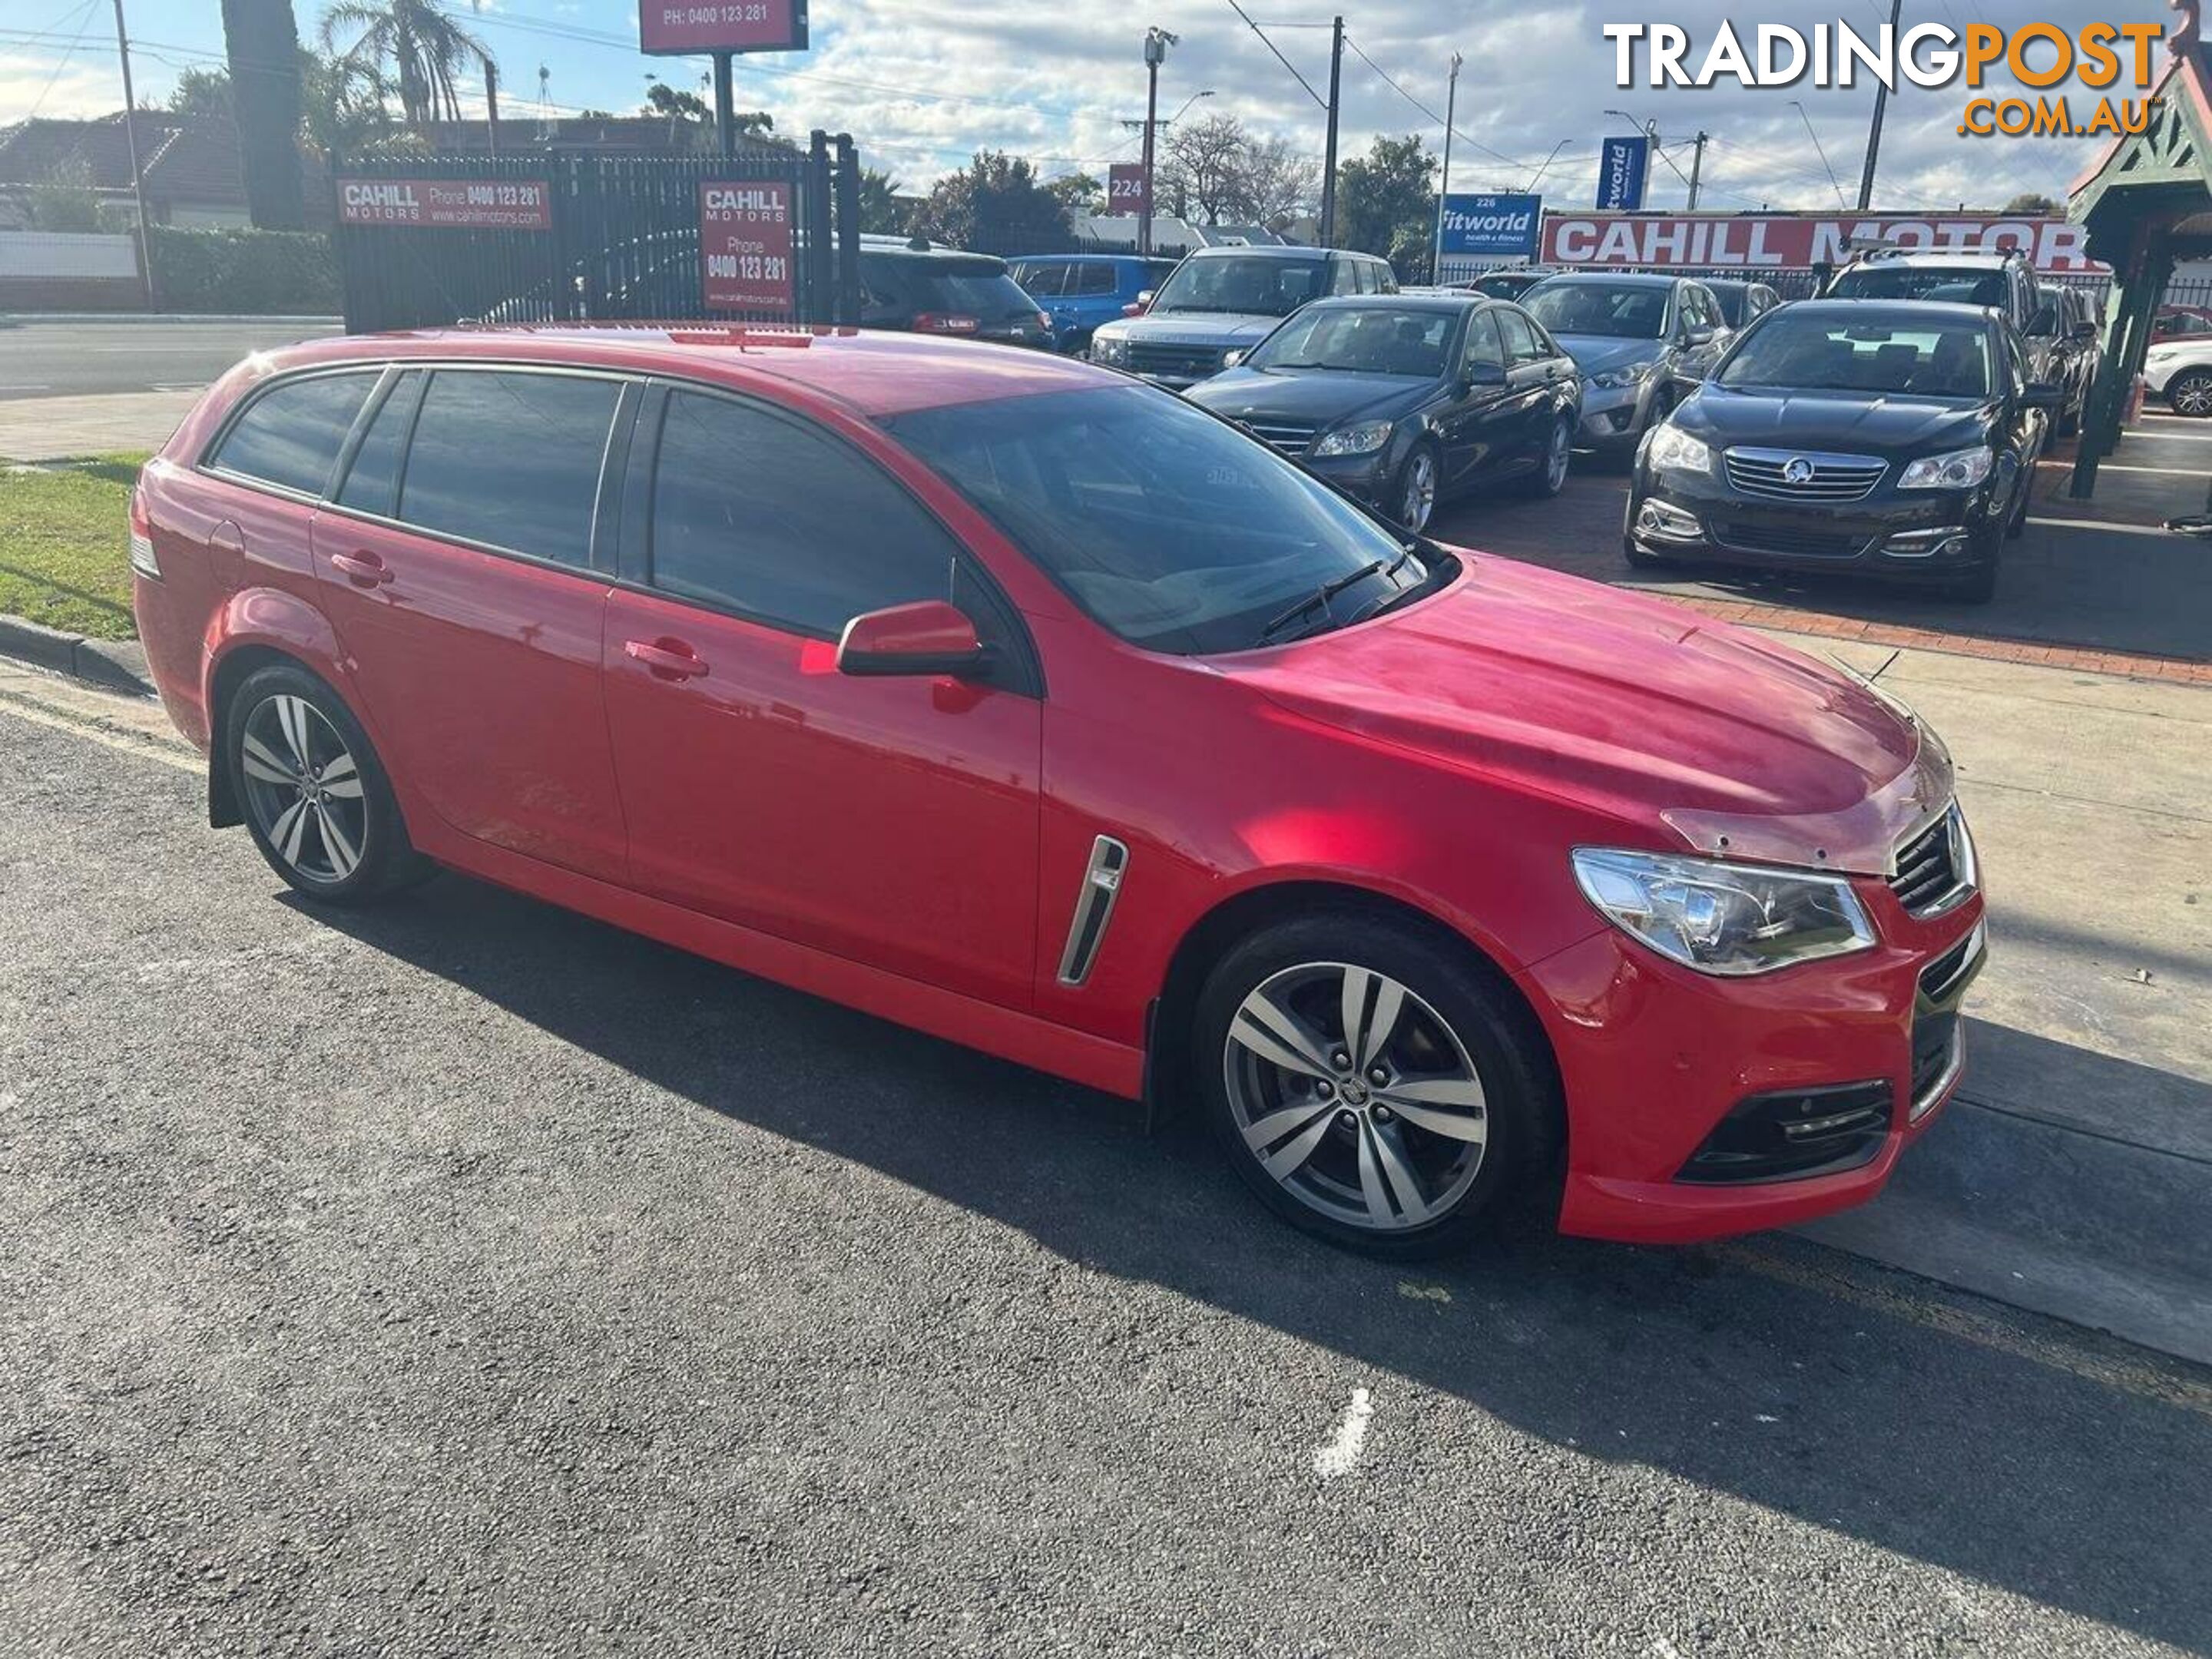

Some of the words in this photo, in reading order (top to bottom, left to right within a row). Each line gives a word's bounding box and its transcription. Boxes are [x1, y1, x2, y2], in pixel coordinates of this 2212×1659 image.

[664, 9, 686, 25] PH:
[689, 8, 717, 24] 0400
[721, 6, 743, 22] 123
[746, 5, 767, 21] 281
[1607, 144, 1625, 208] tworld
[346, 184, 419, 207] CAHILL
[429, 187, 465, 205] Phone
[467, 186, 495, 206] 0400
[497, 186, 518, 206] 123
[520, 187, 541, 207] 281
[1111, 179, 1143, 197] 224
[706, 190, 785, 210] CAHILL
[1475, 197, 1496, 208] 226
[346, 207, 419, 220] MOTORS
[706, 210, 784, 222] MOTORS
[727, 236, 764, 253] Phone
[1555, 220, 1783, 265] CAHILL
[1809, 221, 2114, 270] MOTOR
[707, 254, 737, 278] 0400
[740, 254, 761, 280] 123
[764, 256, 786, 281] 281
